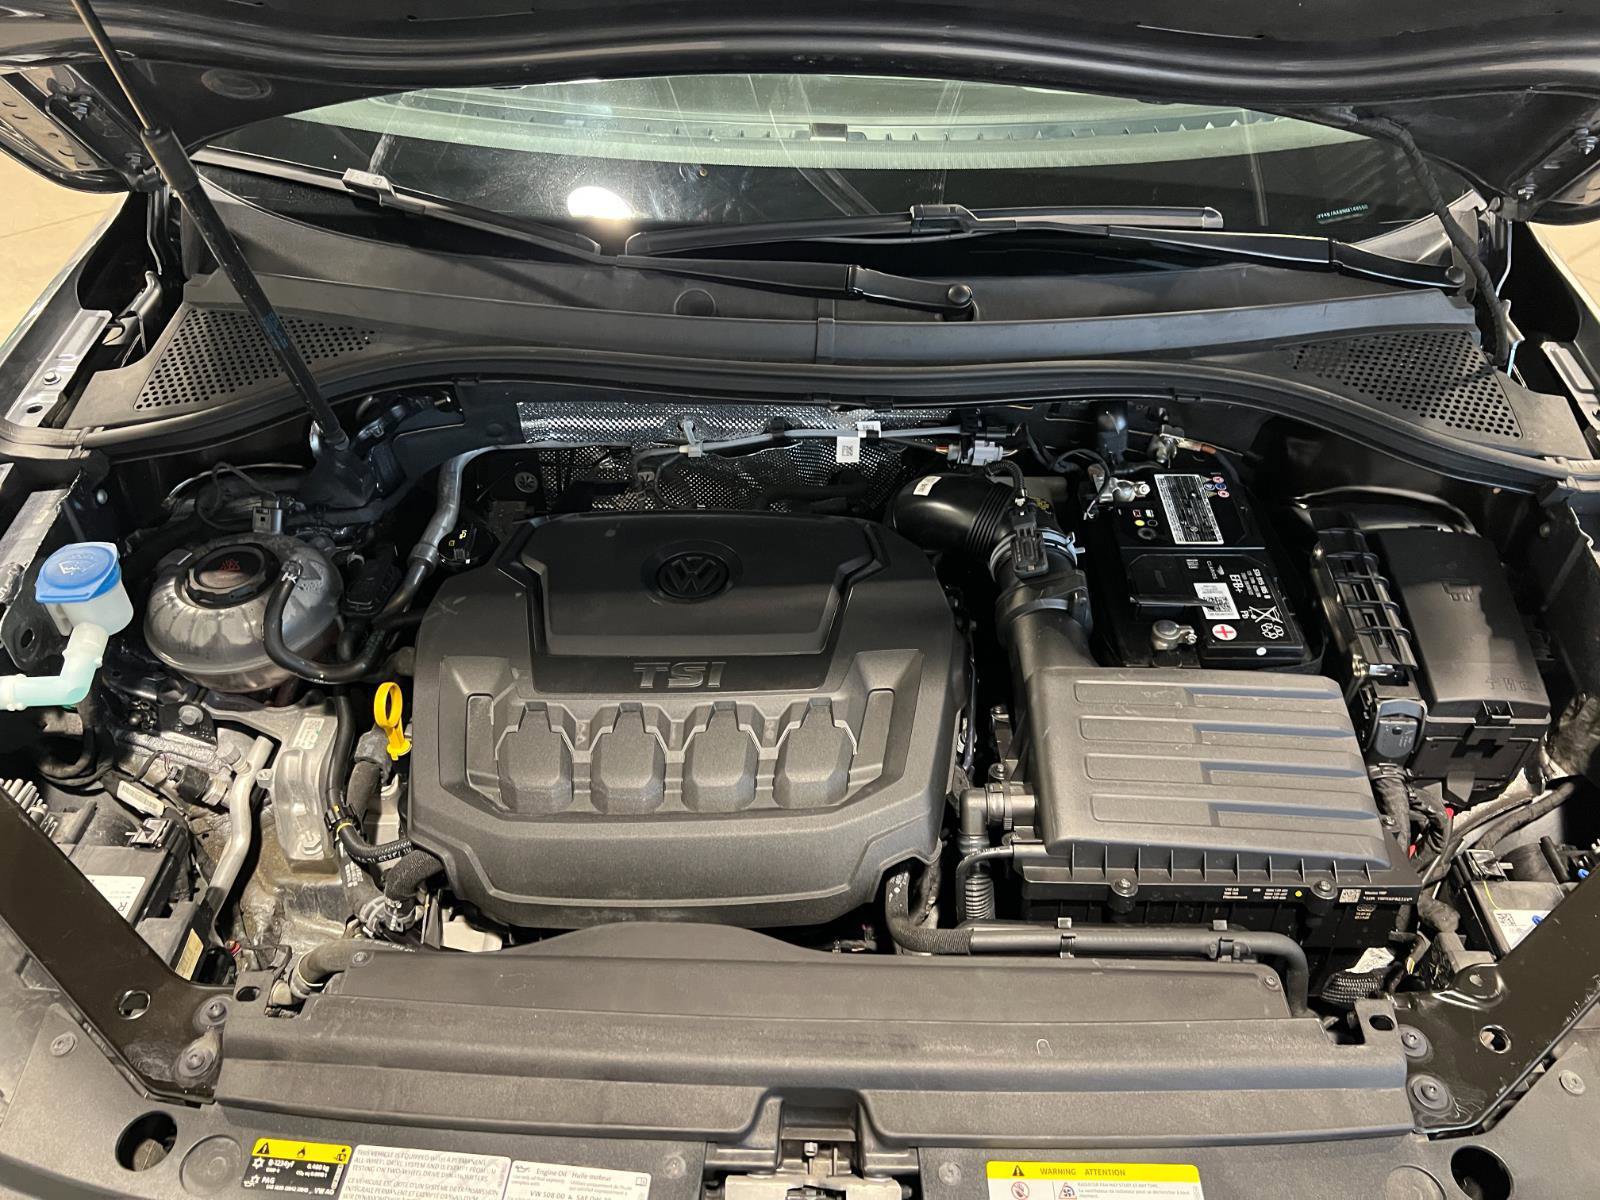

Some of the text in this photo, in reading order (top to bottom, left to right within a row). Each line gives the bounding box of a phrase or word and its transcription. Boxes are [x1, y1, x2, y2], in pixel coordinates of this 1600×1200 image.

[1229, 574, 1244, 592] EFB+
[1240, 610, 1249, 619] Pb
[633, 662, 727, 688] TSI
[536, 1168, 557, 1176] Engine
[1040, 1168, 1076, 1176] WARNING
